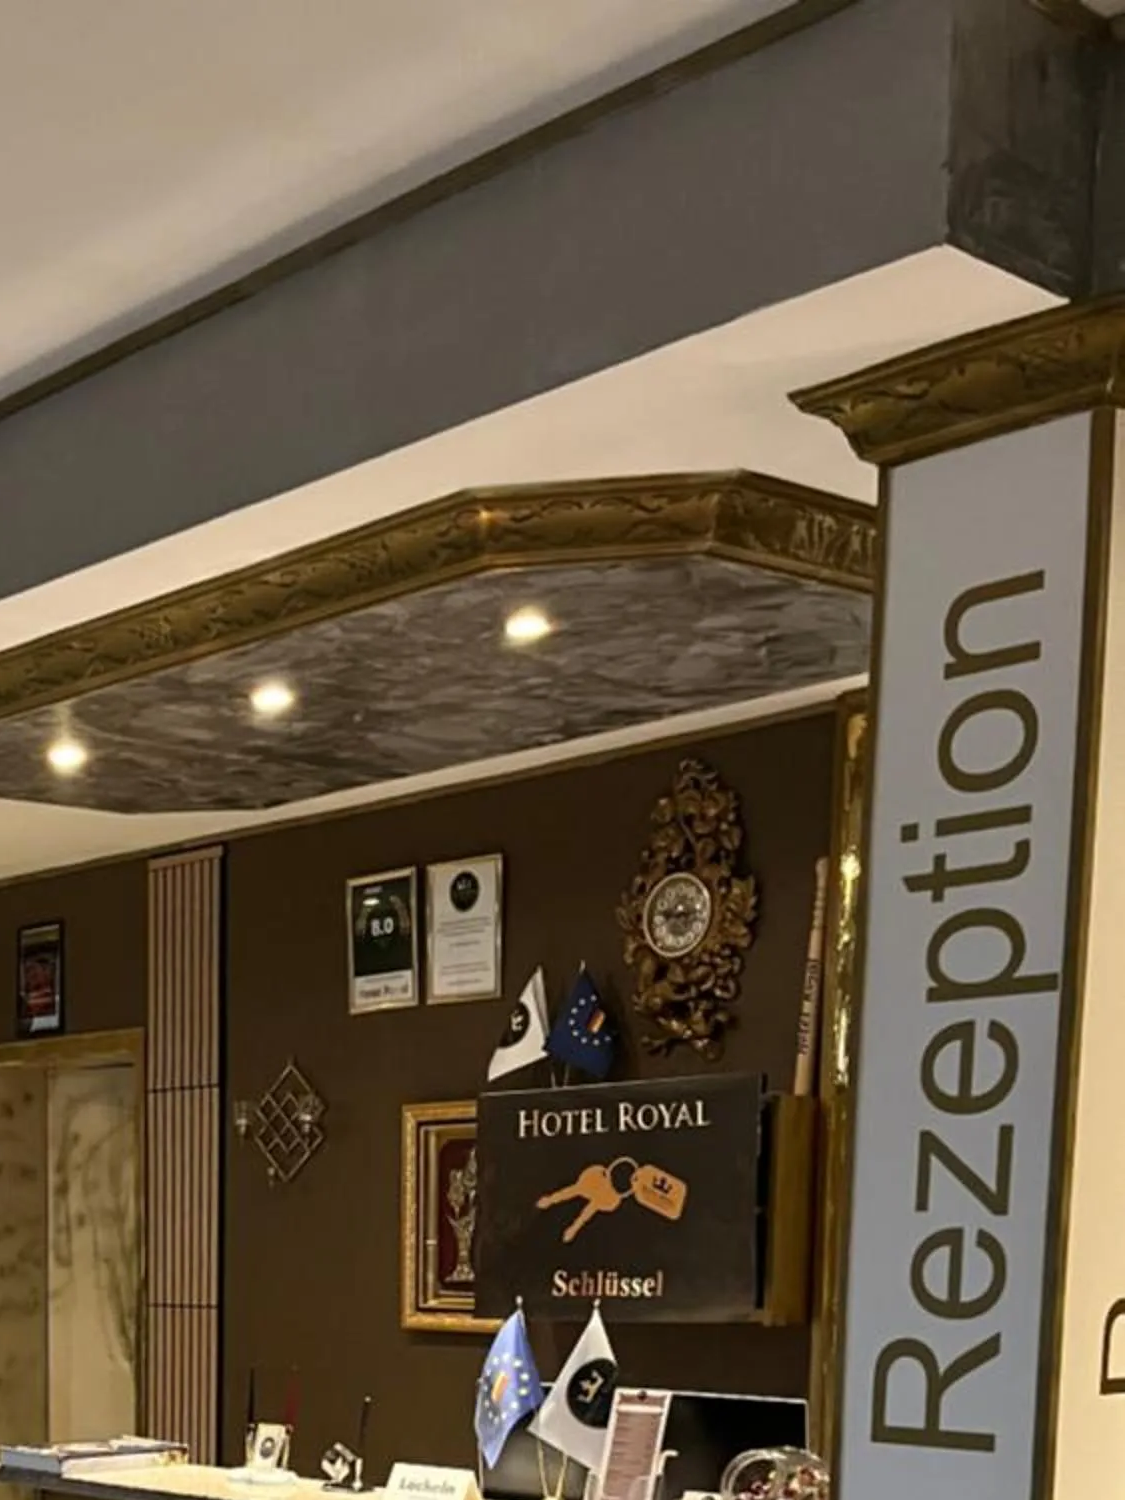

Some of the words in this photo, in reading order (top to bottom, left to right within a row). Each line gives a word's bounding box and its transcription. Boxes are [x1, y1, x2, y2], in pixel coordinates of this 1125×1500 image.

[871, 568, 1059, 1453] Rezeption
[518, 1108, 609, 1139] HOTEL
[618, 1100, 712, 1132] ROYAL
[551, 1269, 664, 1298] Schlüssel
